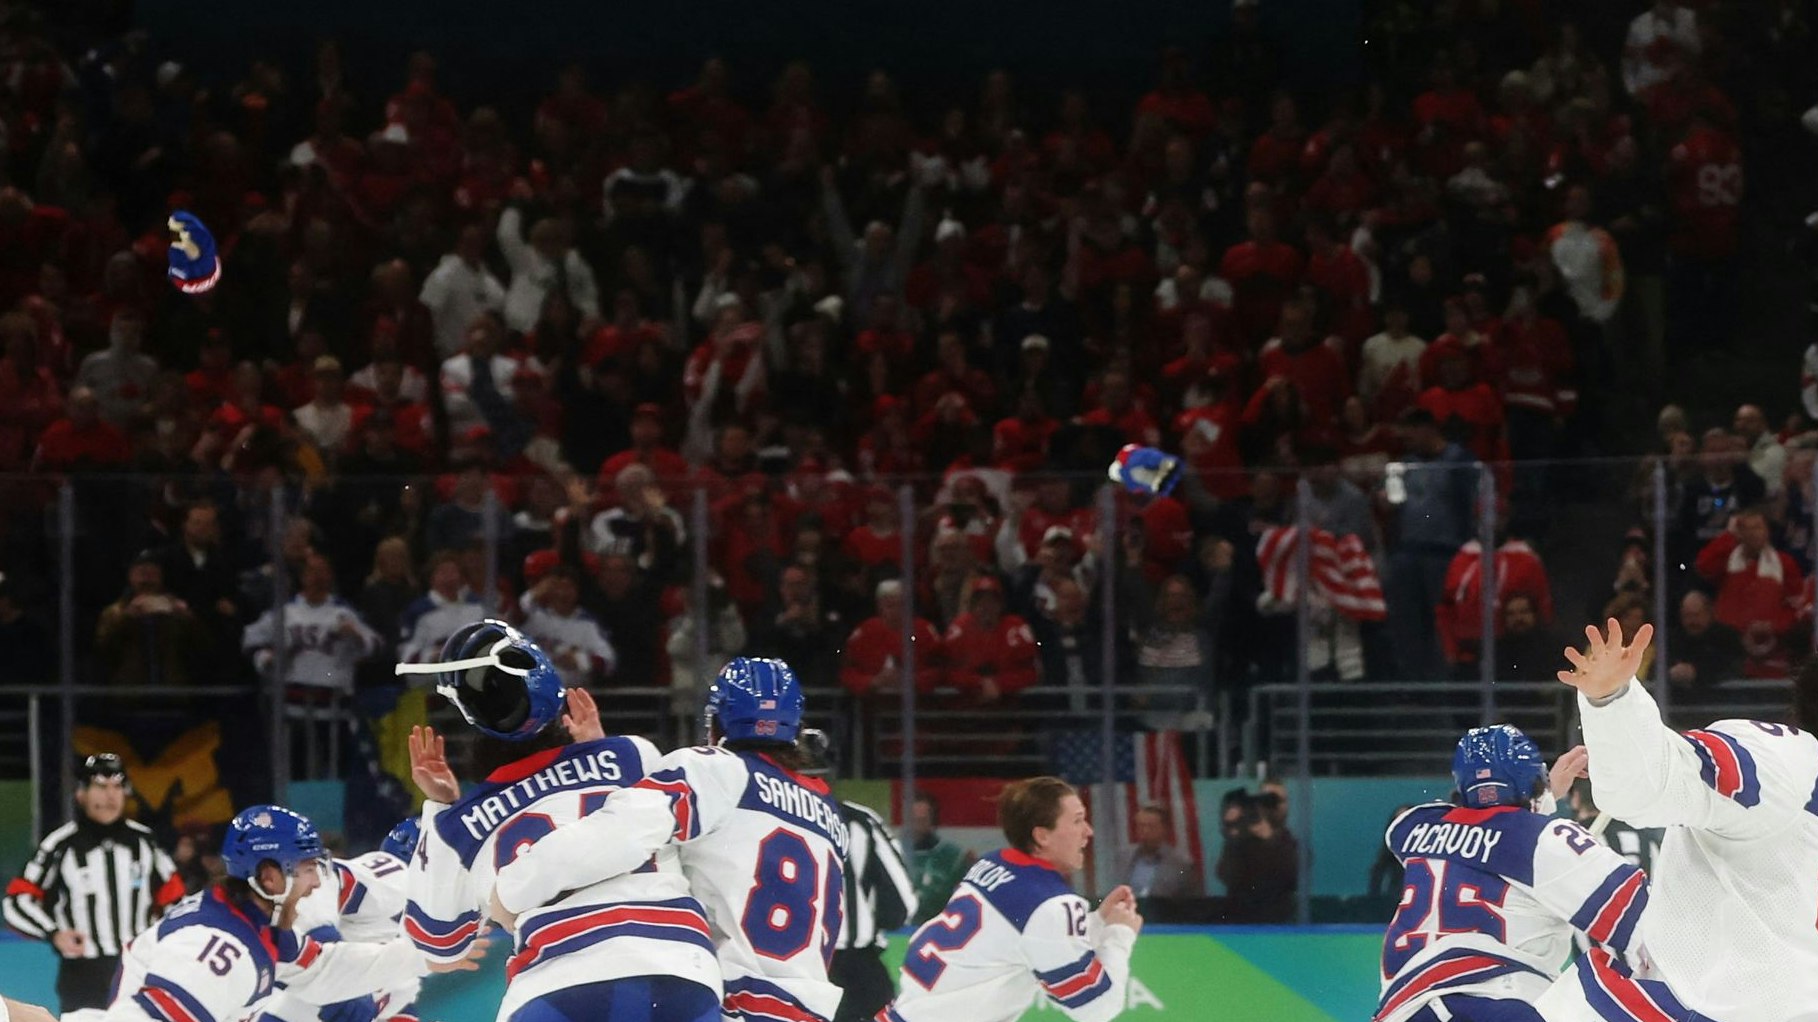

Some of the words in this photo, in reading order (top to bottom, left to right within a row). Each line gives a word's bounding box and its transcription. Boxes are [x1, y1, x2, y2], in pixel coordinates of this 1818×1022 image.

[461, 750, 622, 841] MATTHEWS
[1401, 823, 1502, 863] MCAVOY
[1063, 901, 1087, 936] 12
[196, 934, 241, 976] 15
